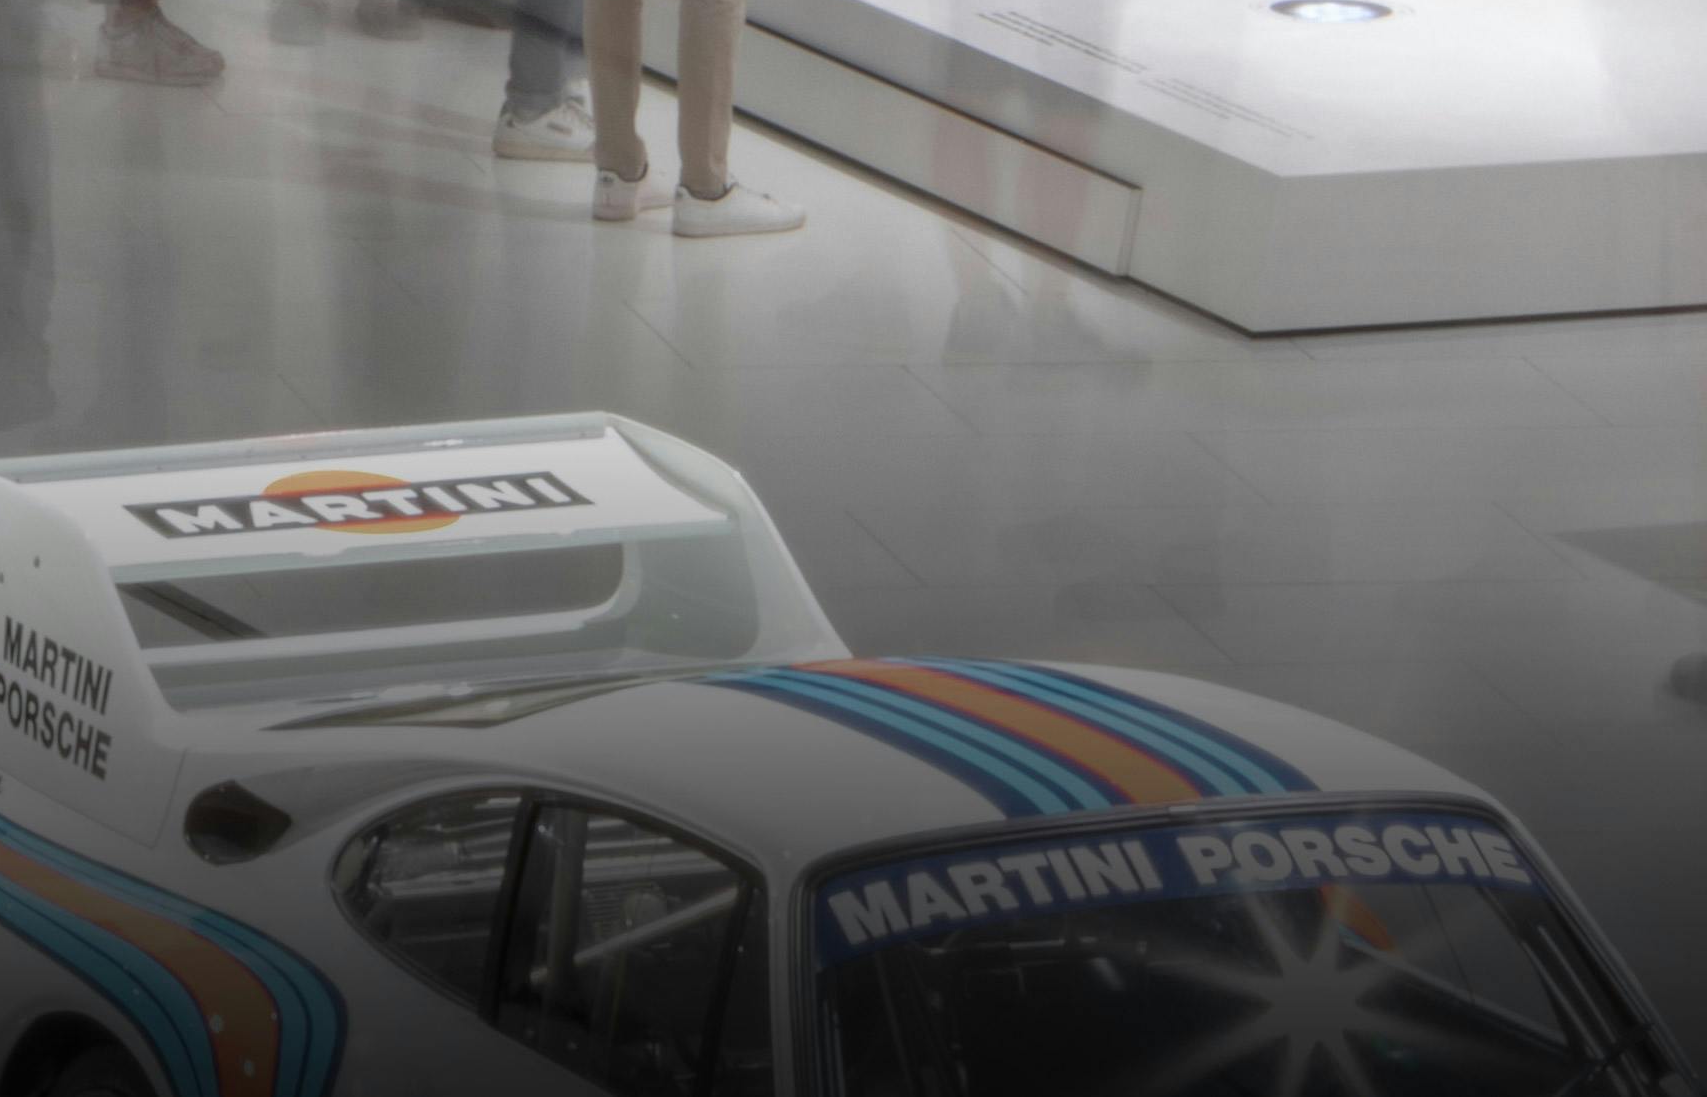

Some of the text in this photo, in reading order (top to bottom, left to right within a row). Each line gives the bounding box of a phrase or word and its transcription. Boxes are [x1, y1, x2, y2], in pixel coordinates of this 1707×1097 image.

[155, 472, 571, 538] MARTINI
[2, 615, 115, 715] MARTINI
[827, 823, 1534, 947] MARTINI PORSCHE
